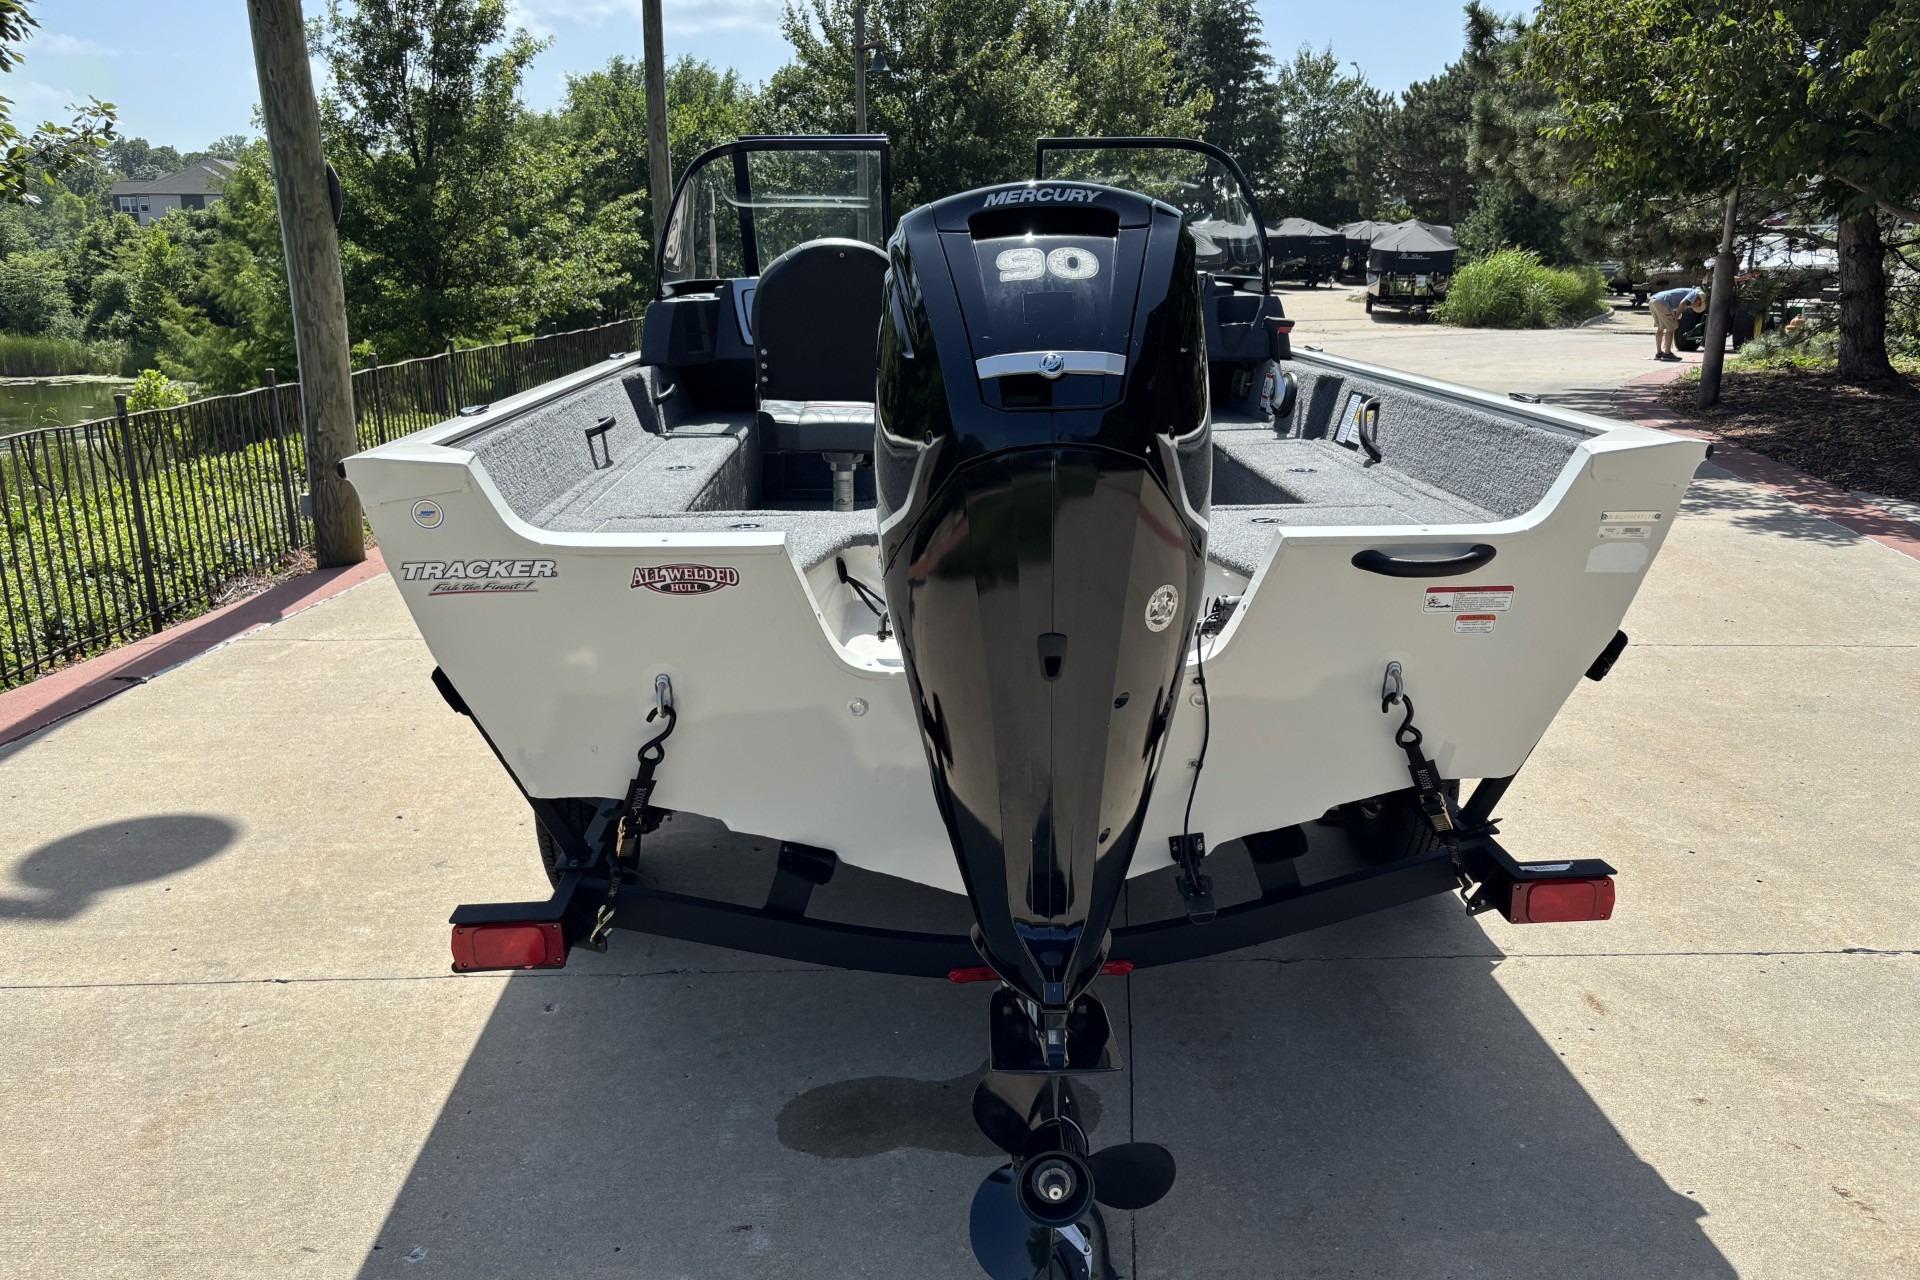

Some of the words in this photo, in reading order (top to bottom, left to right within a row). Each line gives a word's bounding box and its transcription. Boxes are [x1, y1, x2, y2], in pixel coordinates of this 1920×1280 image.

[984, 187, 1102, 208] MERCURY
[995, 247, 1100, 282] 90
[401, 559, 556, 581] TRACKER
[631, 567, 667, 588] ALL
[661, 567, 739, 586] WELDED
[432, 582, 460, 592] Fish
[461, 582, 481, 591] the
[670, 583, 702, 592] HULL
